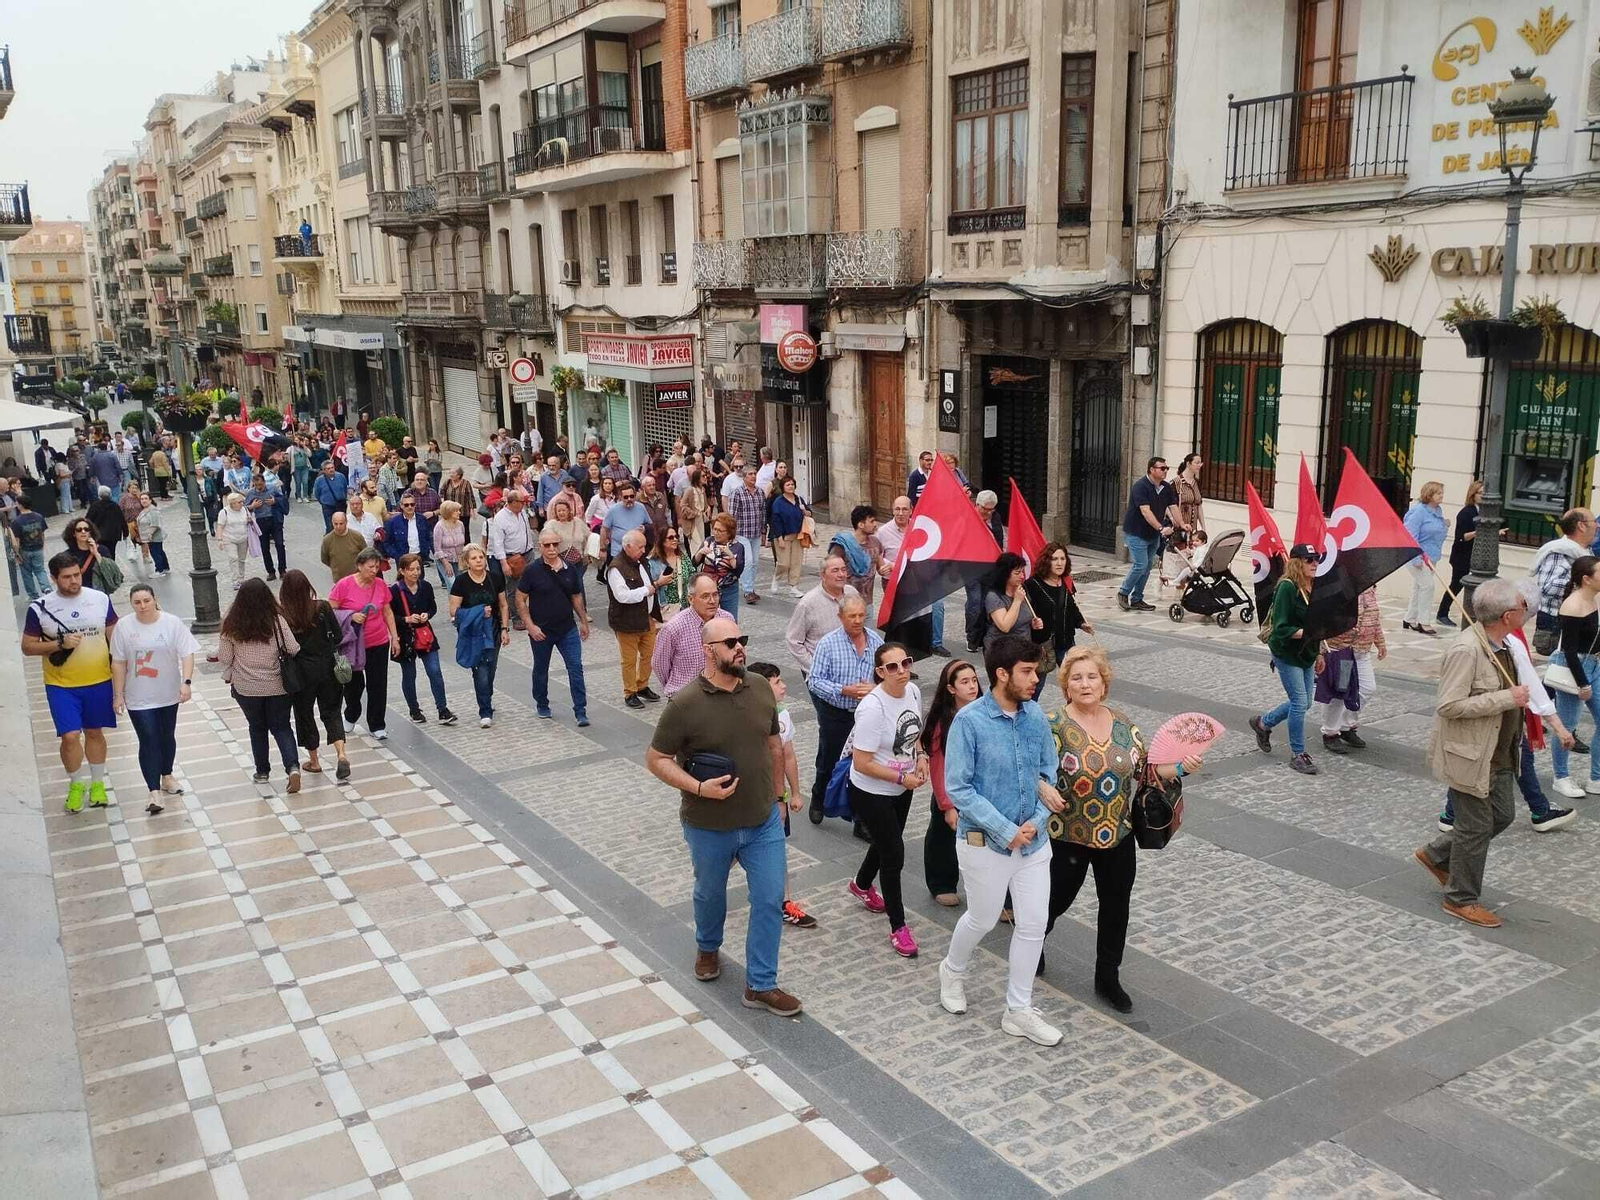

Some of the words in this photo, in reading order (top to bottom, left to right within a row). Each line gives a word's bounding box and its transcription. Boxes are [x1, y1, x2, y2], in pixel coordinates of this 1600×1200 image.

[1451, 77, 1546, 106] CENTO
[1432, 122, 1459, 142] DE
[1442, 153, 1470, 174] DE
[627, 342, 648, 366] JAVIER
[652, 348, 690, 360] JAVIER
[784, 346, 813, 355] Mahou
[658, 391, 688, 400] JAVIER
